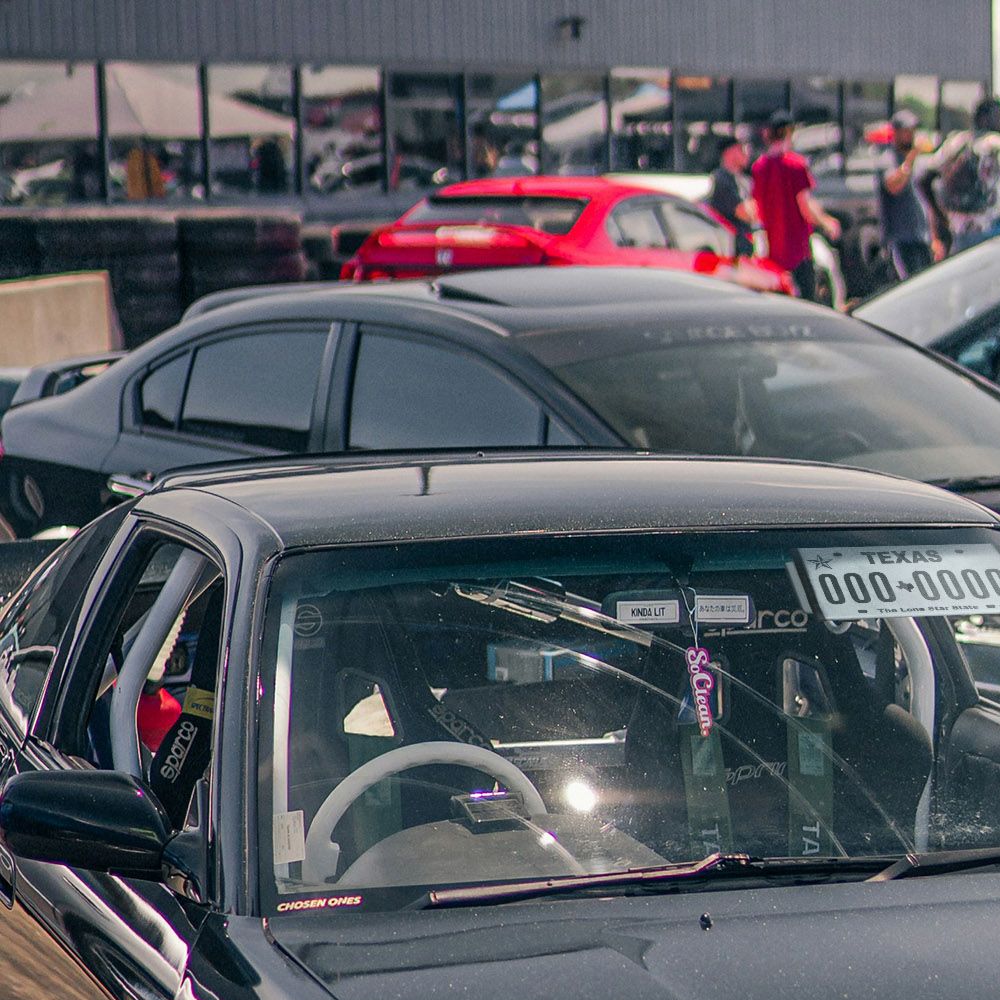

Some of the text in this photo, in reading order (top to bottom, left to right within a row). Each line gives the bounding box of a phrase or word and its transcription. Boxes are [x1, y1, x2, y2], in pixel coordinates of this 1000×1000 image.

[860, 550, 943, 565] TEXAS
[631, 607, 666, 617] KINDA LIT
[161, 721, 196, 781] sparco
[277, 896, 362, 912] CHOSEN ONES
